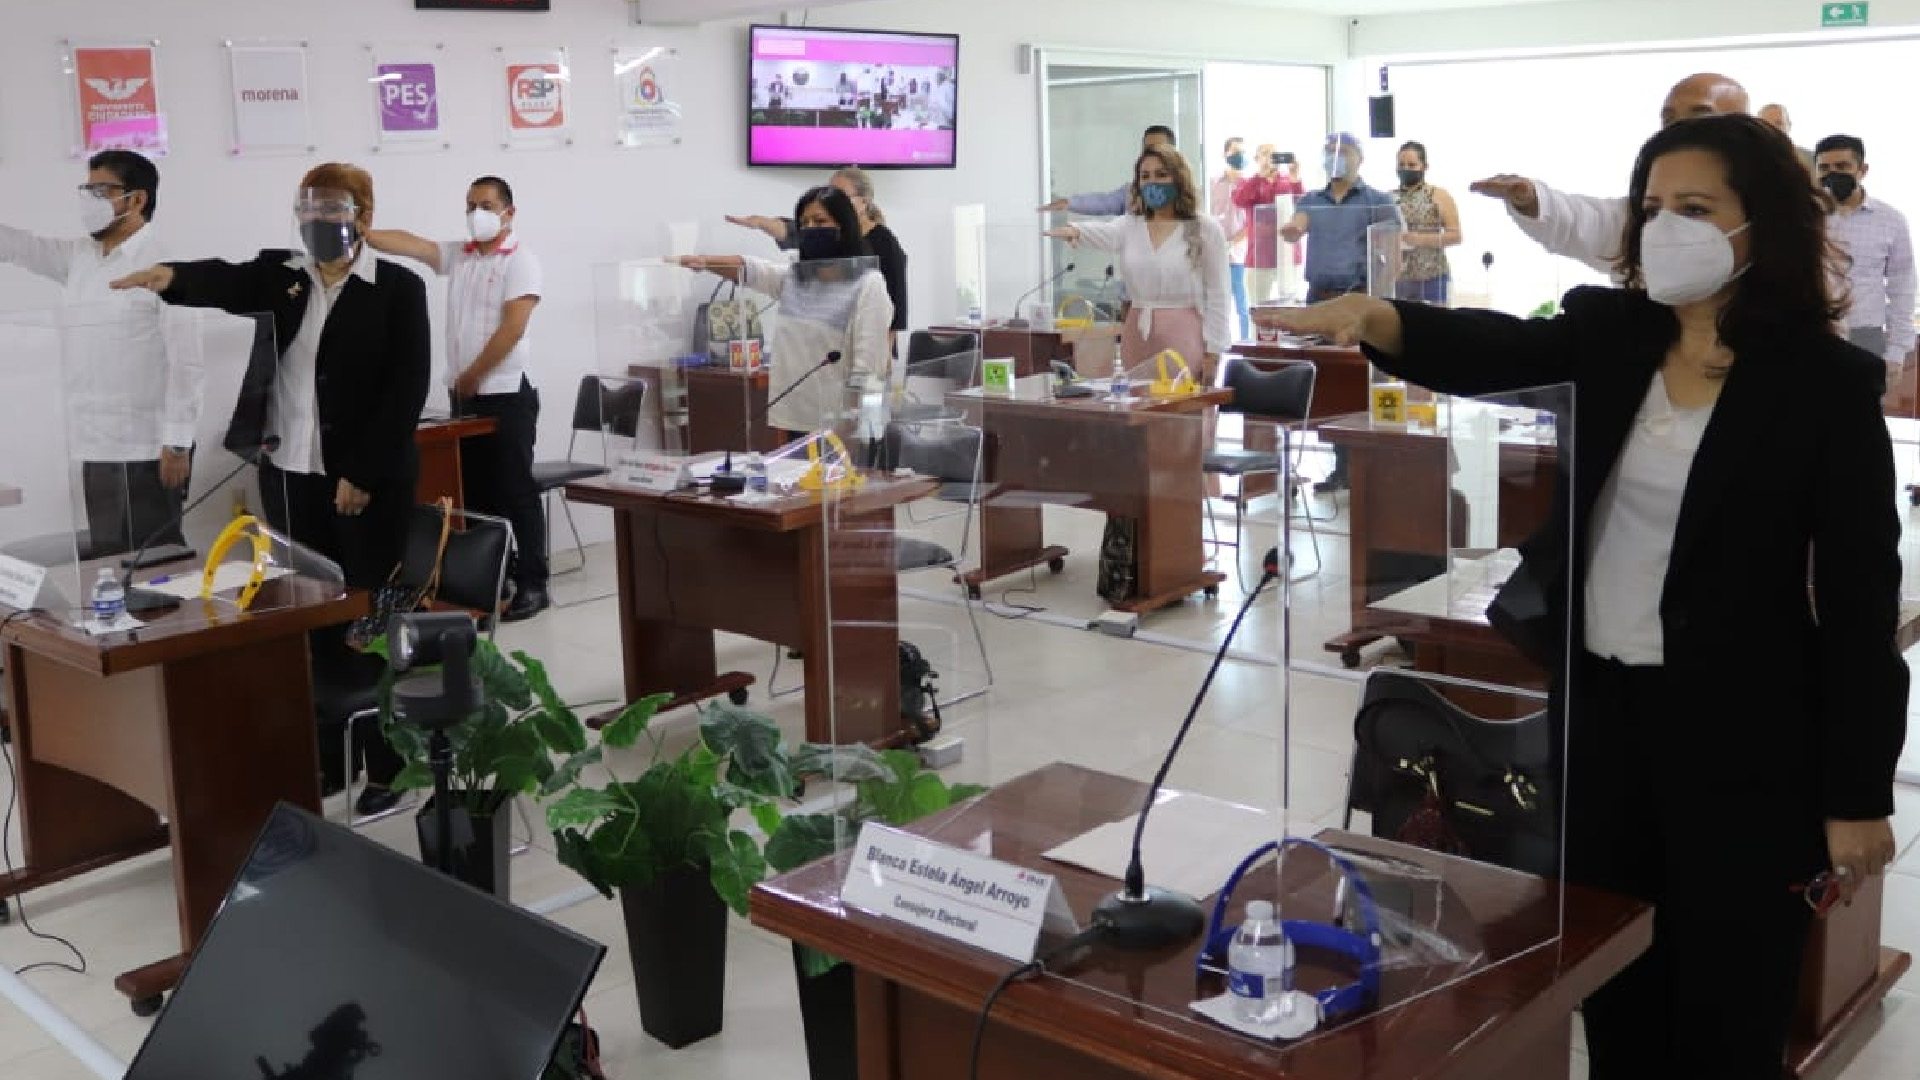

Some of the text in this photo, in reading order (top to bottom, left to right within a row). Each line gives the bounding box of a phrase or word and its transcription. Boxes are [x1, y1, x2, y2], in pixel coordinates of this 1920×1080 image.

[242, 88, 299, 102] morena
[386, 83, 429, 106] PES
[517, 79, 554, 99] RSP
[867, 845, 1030, 908] Blanca Estela Ángel Arroyo
[937, 908, 979, 932] Electoral
